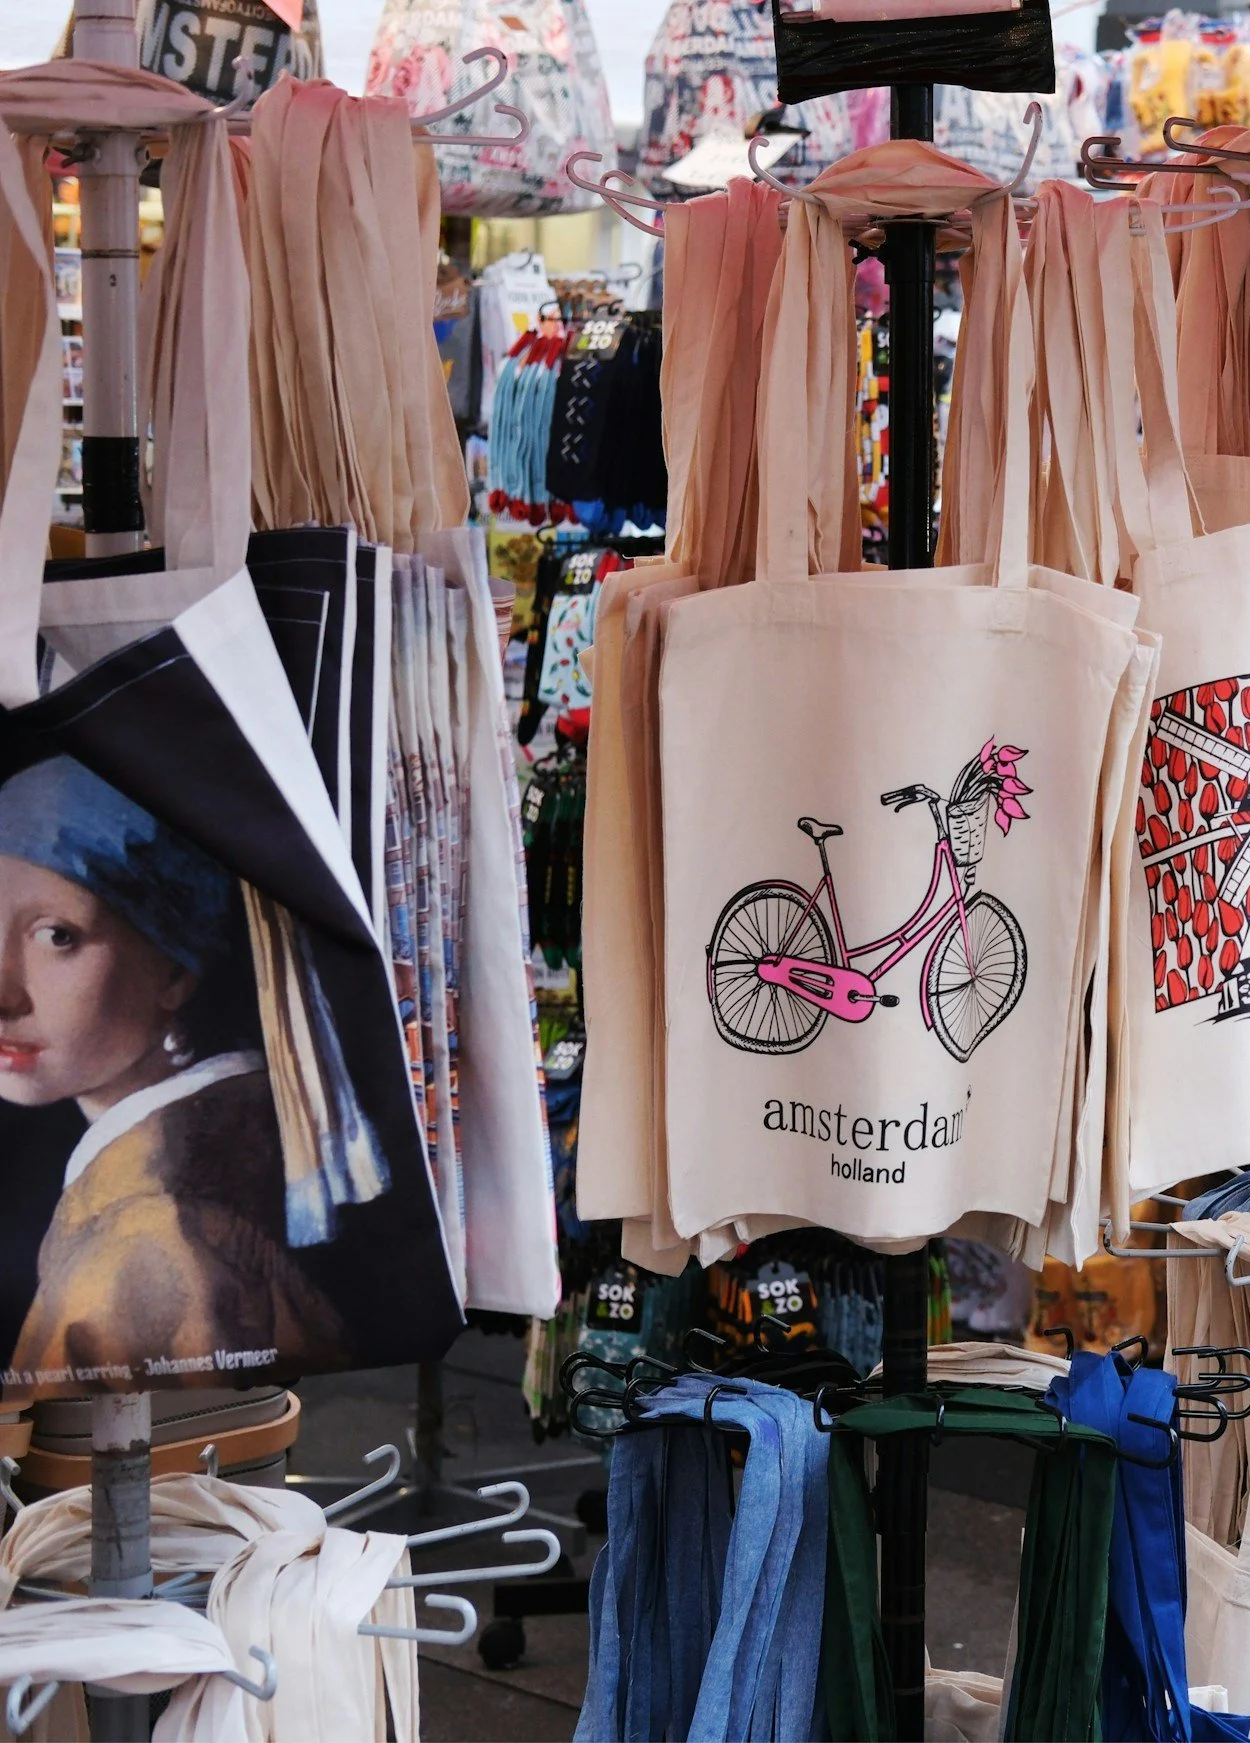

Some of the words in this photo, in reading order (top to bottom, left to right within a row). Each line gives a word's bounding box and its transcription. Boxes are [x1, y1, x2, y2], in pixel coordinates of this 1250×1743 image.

[582, 319, 619, 335] SOK
[763, 1099, 964, 1151] amsterdam
[831, 1153, 906, 1184] holland
[598, 1283, 636, 1302] SOK
[757, 1278, 800, 1300] SOK
[35, 1364, 75, 1386] pearl
[76, 1361, 133, 1381] earring
[143, 1356, 214, 1377] Johannes
[214, 1348, 279, 1370] Vermeer
